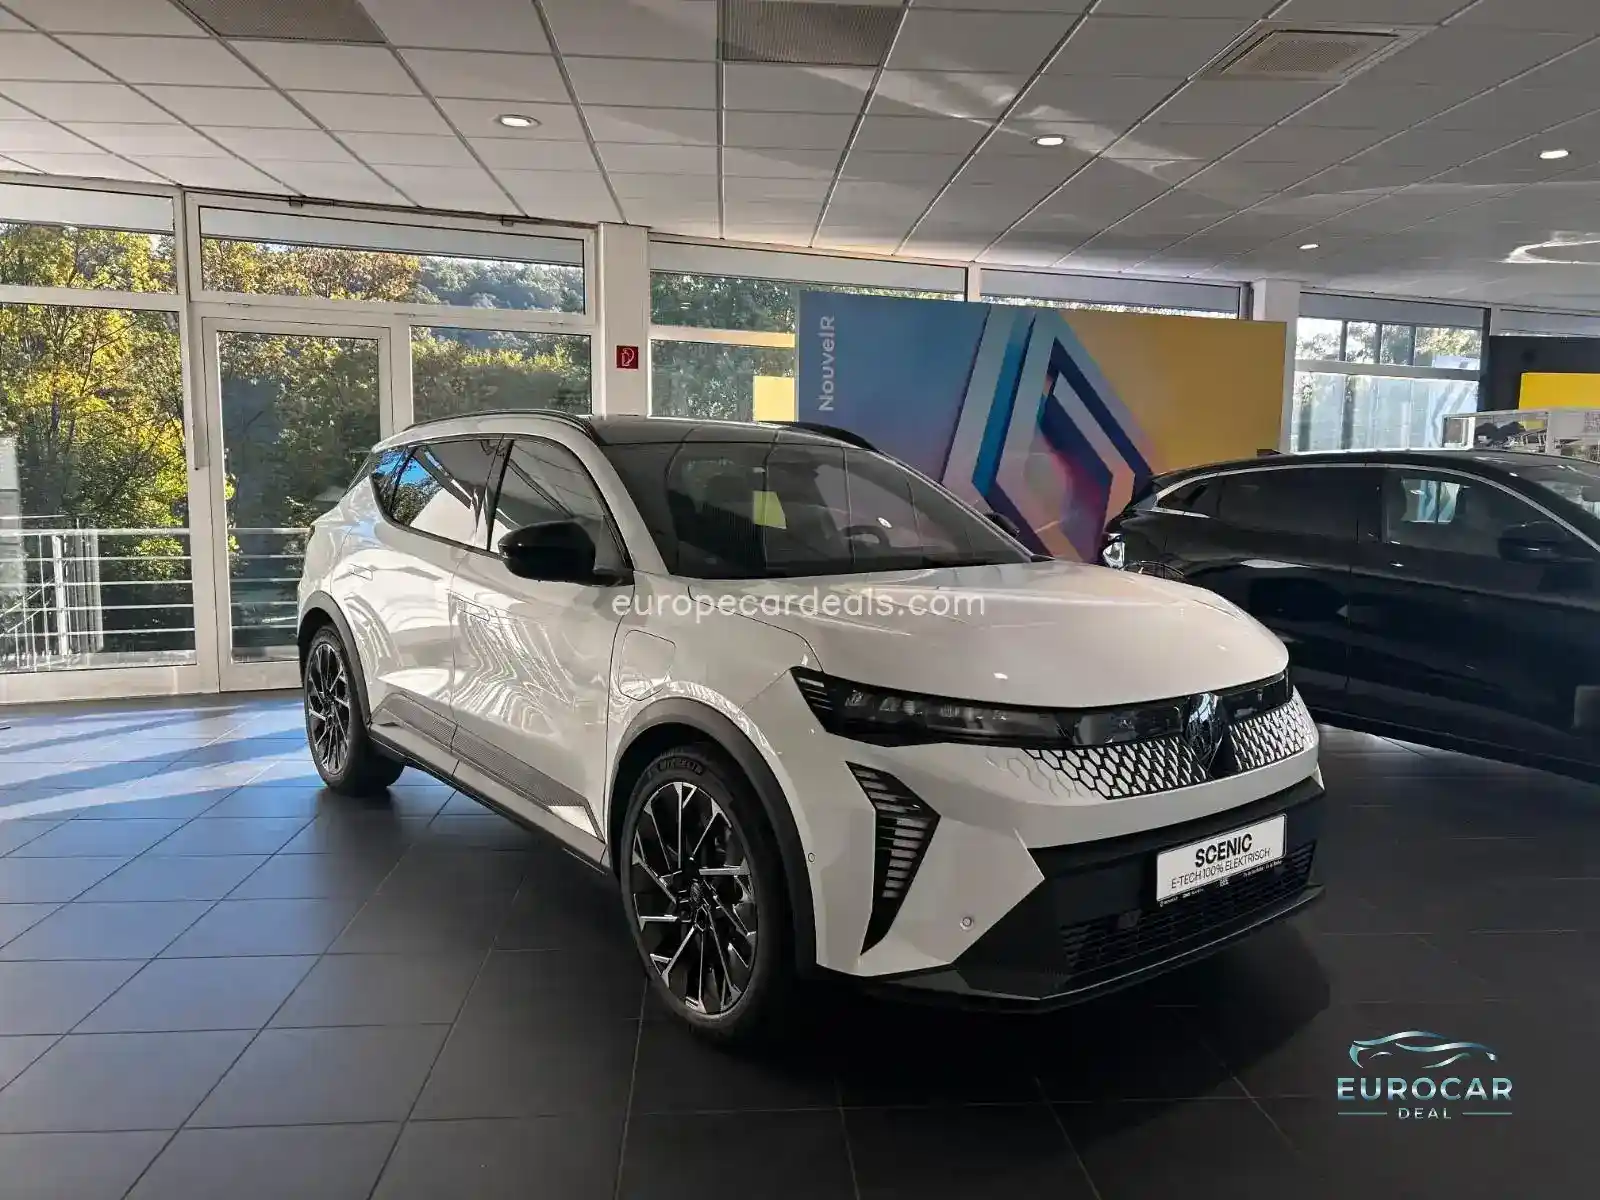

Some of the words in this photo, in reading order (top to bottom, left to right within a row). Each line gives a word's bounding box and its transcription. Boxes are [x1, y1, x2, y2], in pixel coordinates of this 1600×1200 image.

[818, 315, 835, 411] NouvelR
[1171, 869, 1202, 889] E-TECH
[1203, 863, 1224, 879] 100%
[1225, 847, 1271, 872] ELEKTRISCH
[1195, 833, 1253, 868] SCENIC
